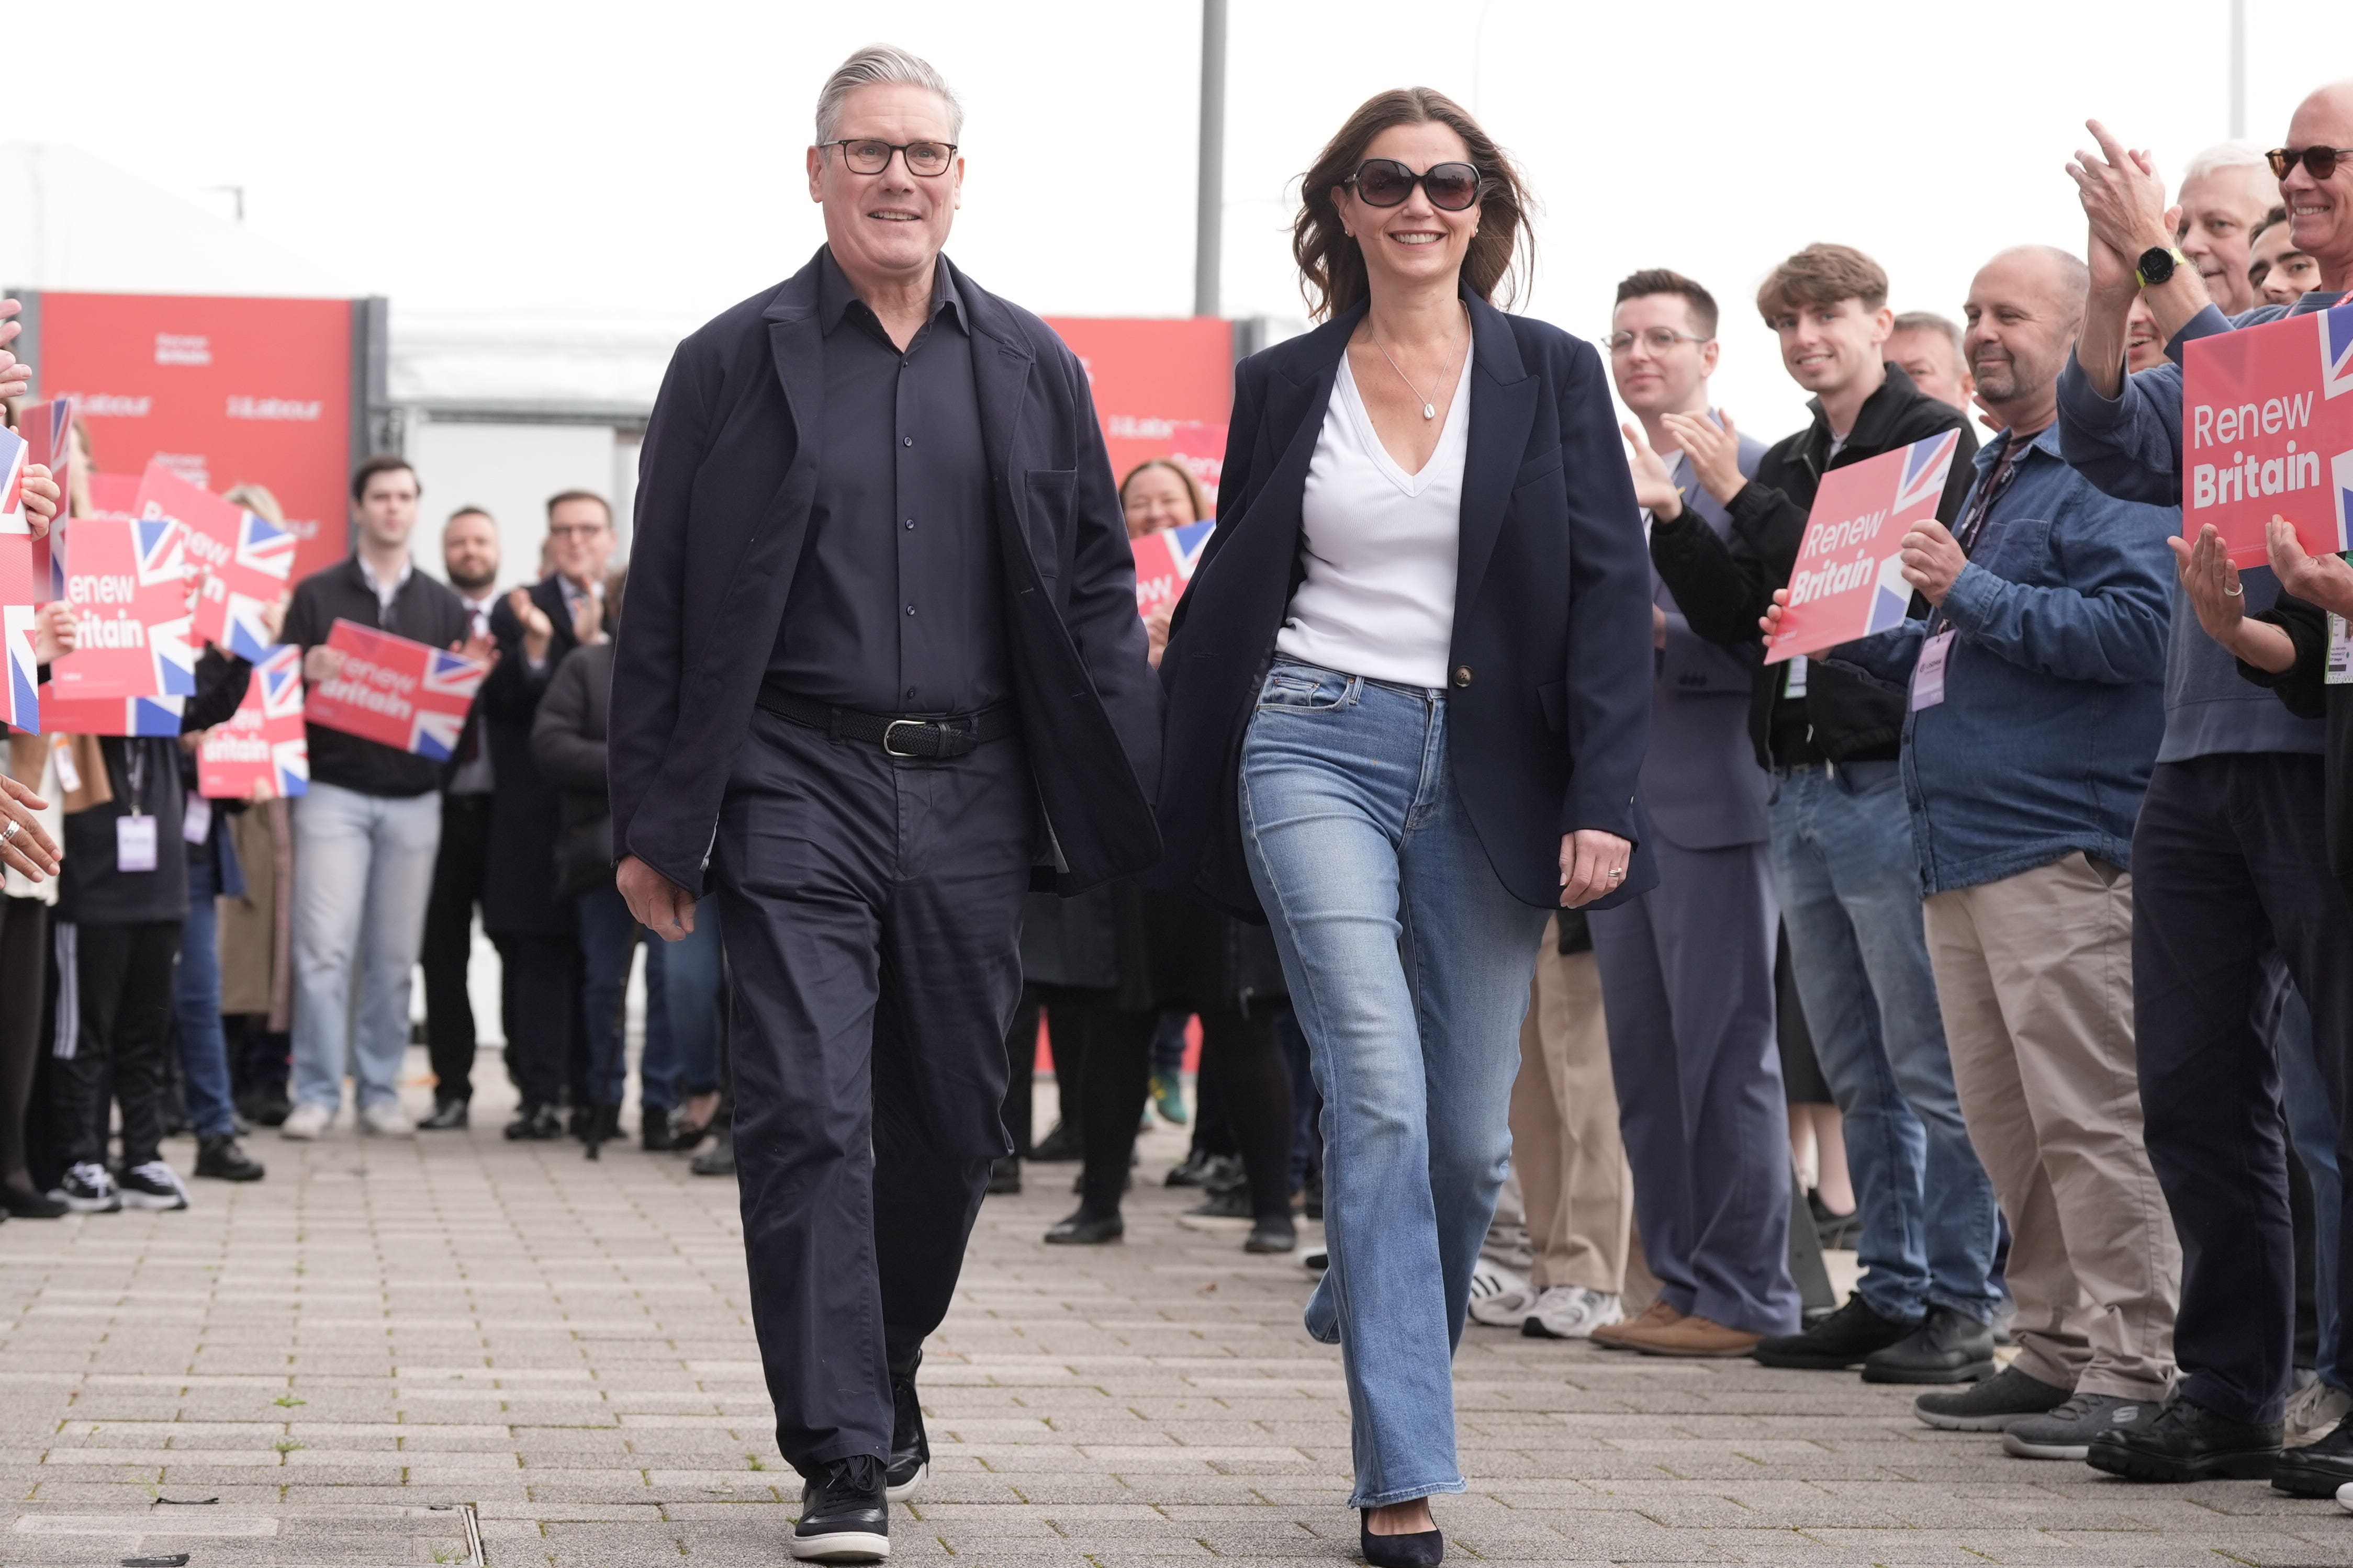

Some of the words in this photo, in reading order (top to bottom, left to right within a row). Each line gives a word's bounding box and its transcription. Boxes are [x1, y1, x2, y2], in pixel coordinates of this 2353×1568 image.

[2194, 390, 2314, 449] Renew
[2193, 439, 2320, 509] Britain
[1803, 508, 1888, 559] Renew
[68, 575, 135, 604] enew
[1788, 548, 1875, 607] Britain
[75, 608, 144, 649] ritain
